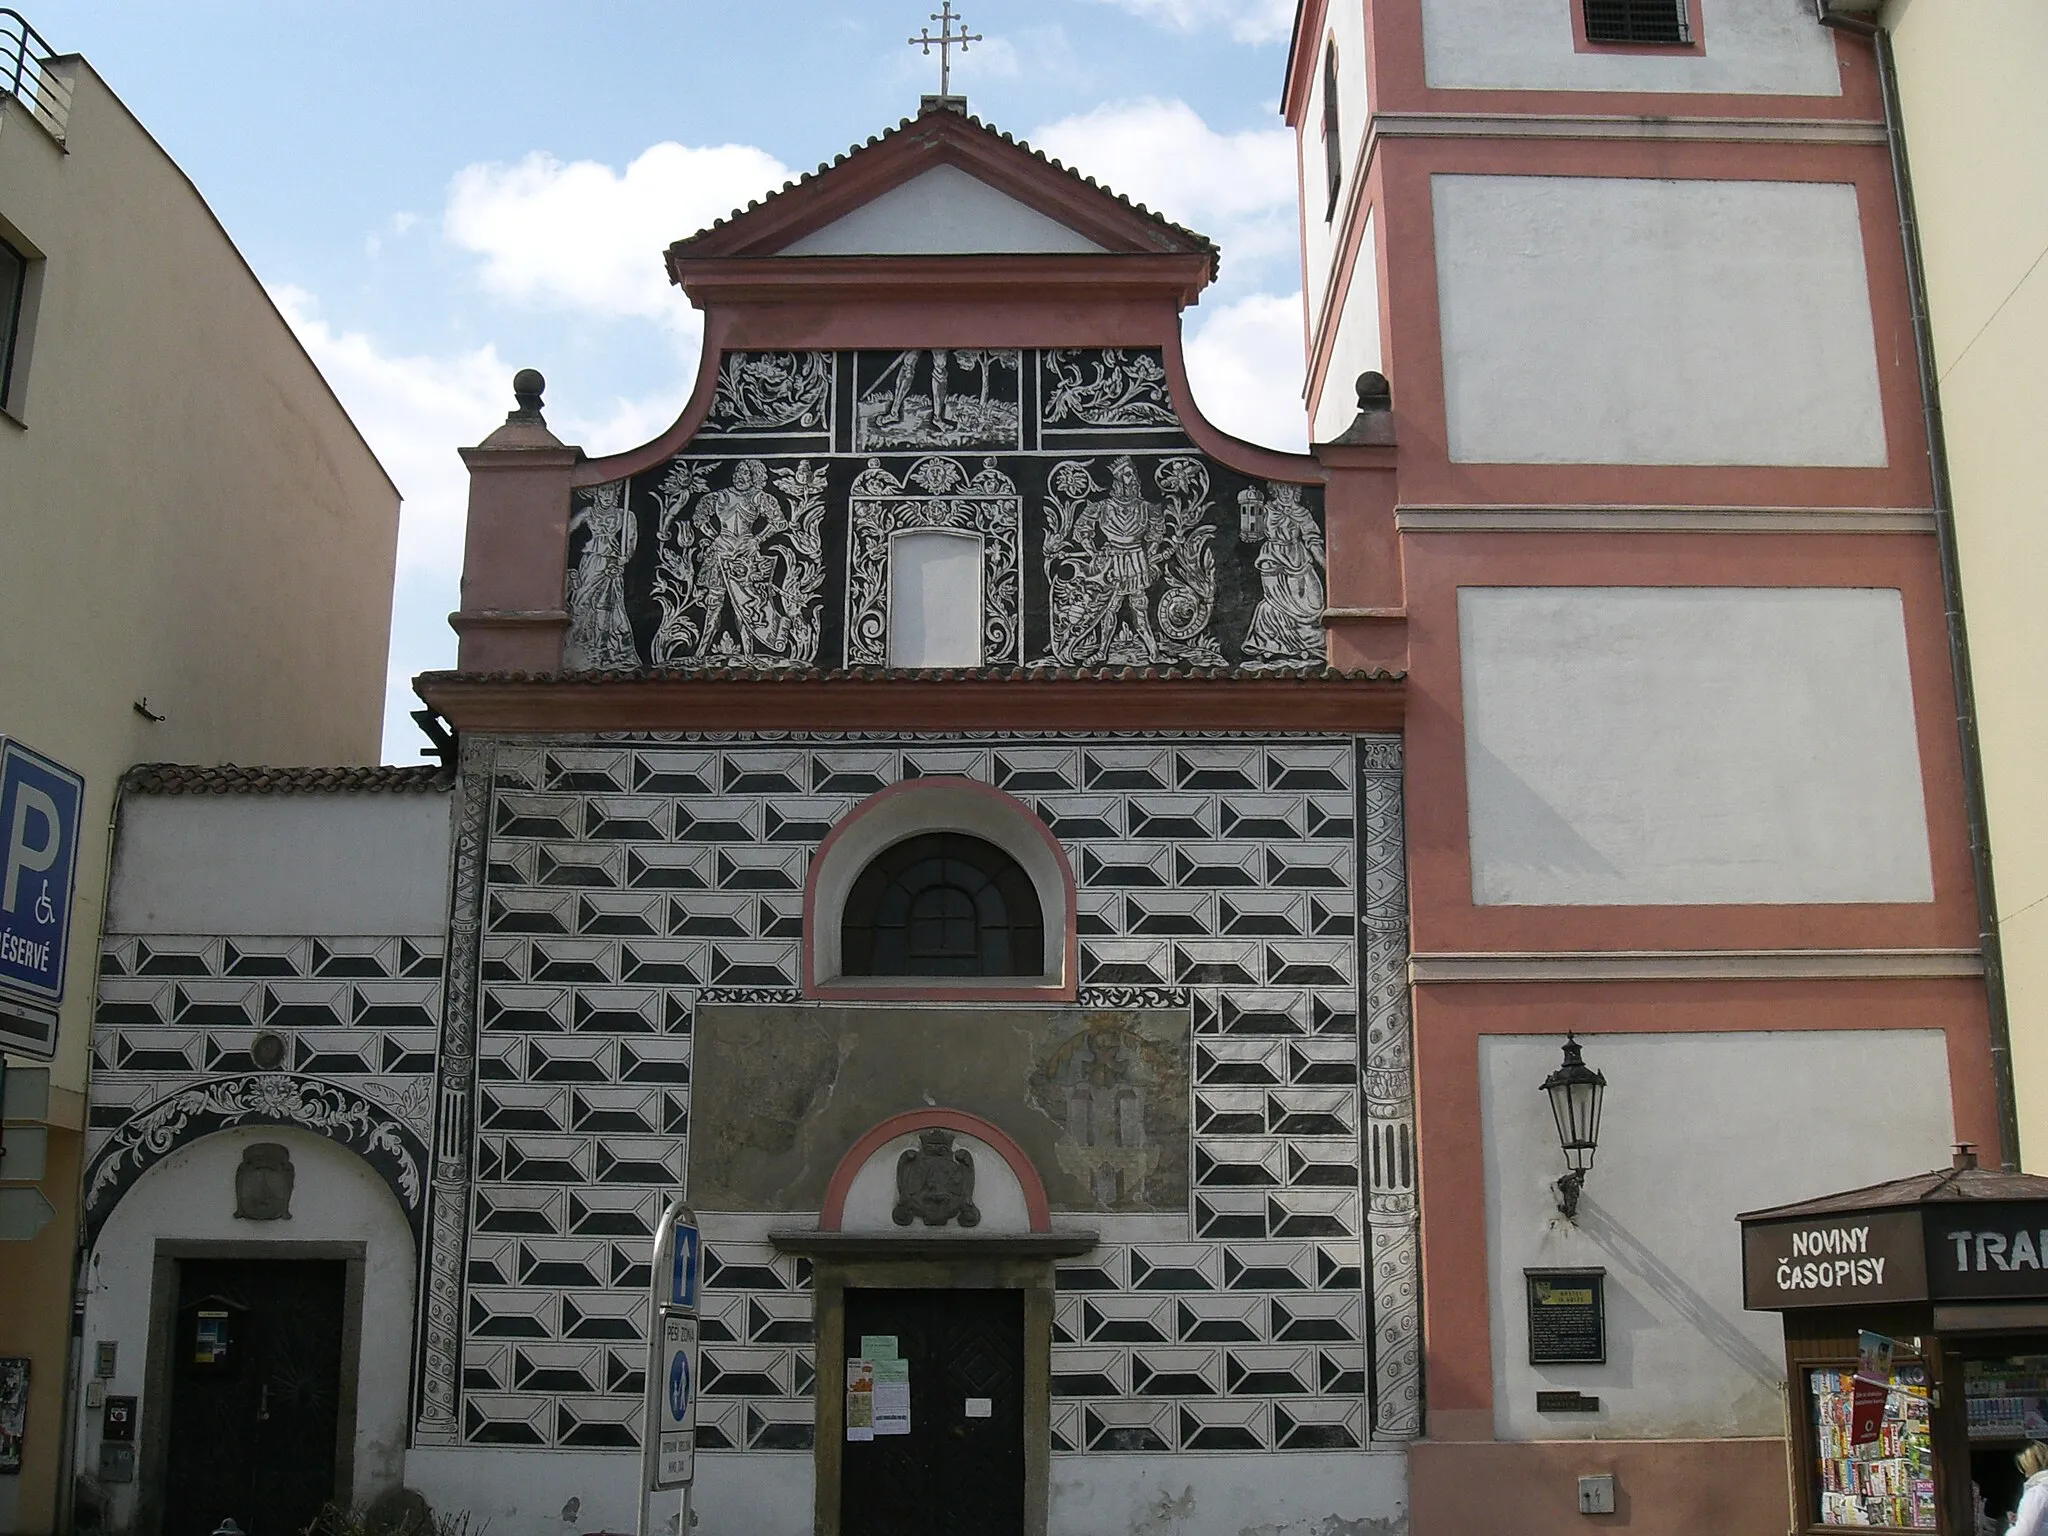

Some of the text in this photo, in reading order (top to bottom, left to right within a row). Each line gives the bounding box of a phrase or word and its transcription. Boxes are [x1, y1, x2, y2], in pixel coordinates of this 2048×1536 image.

[2, 780, 61, 914] P
[0, 927, 51, 972] ÉSERVÉ
[1792, 1226, 1870, 1258] NOVINY
[1776, 1257, 1886, 1290] ČASOPISY
